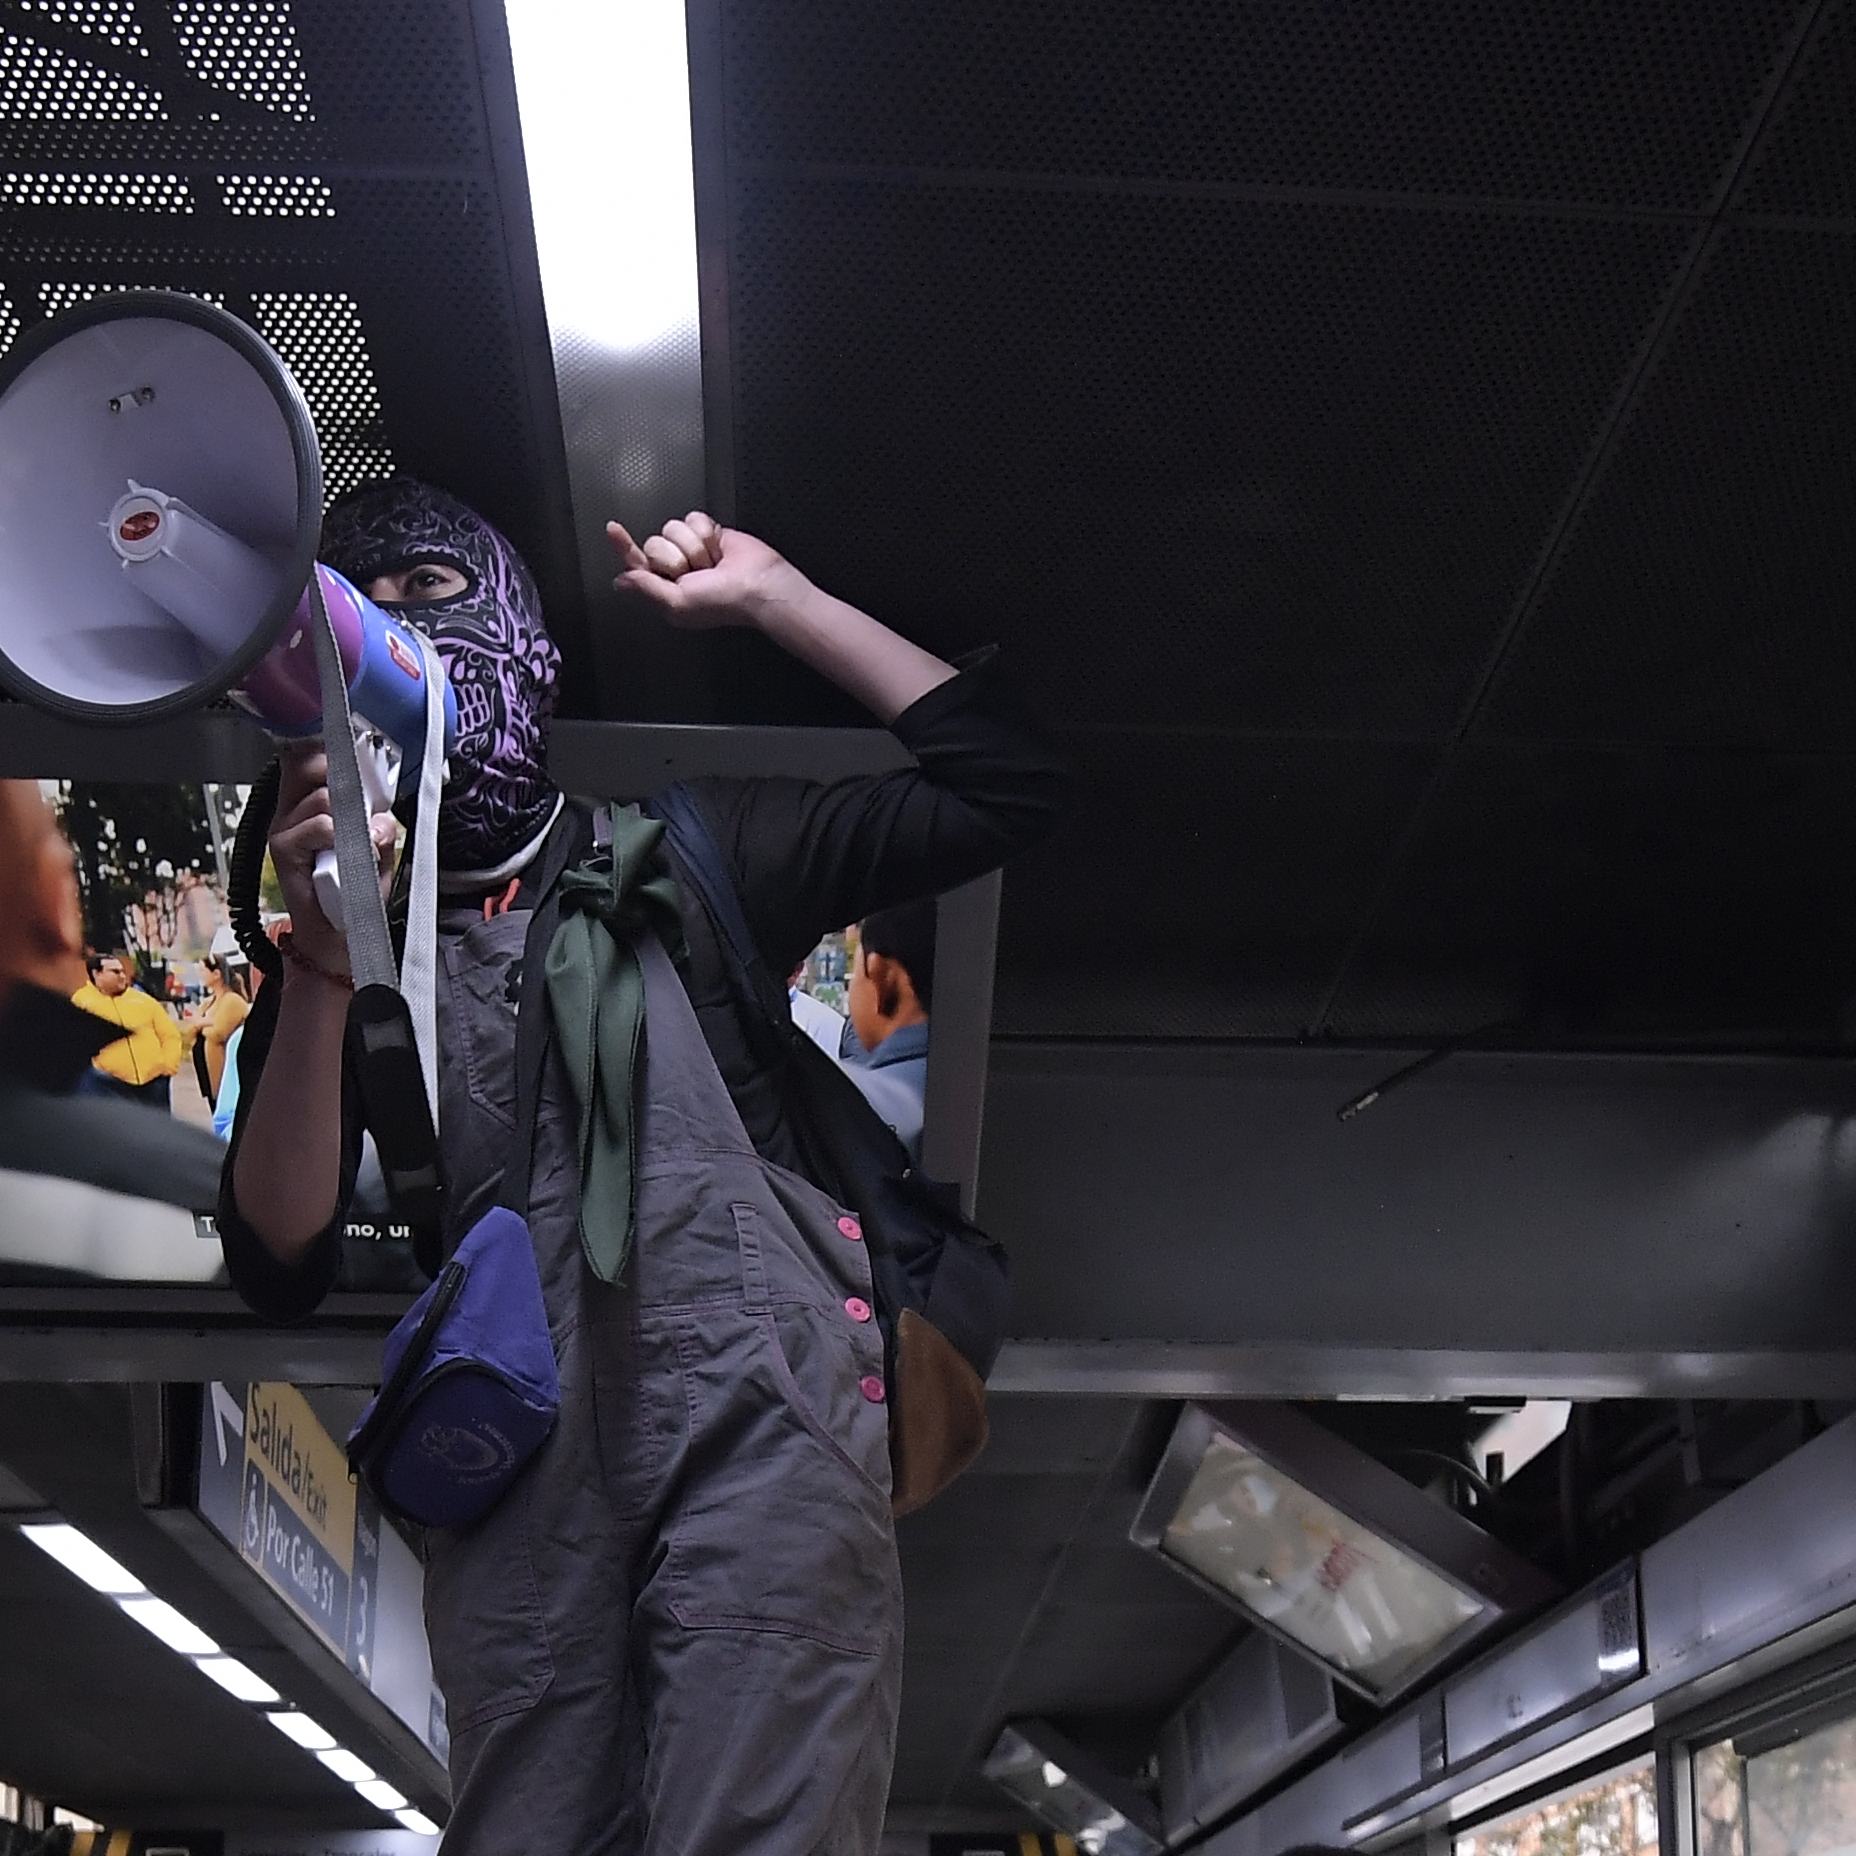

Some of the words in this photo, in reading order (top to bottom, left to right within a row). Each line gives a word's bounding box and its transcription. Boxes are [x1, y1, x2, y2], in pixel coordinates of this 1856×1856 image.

[344, 1222, 383, 1241] no,
[266, 1510, 290, 1570] Por
[291, 1533, 319, 1604] Calle
[320, 1564, 335, 1618] 51
